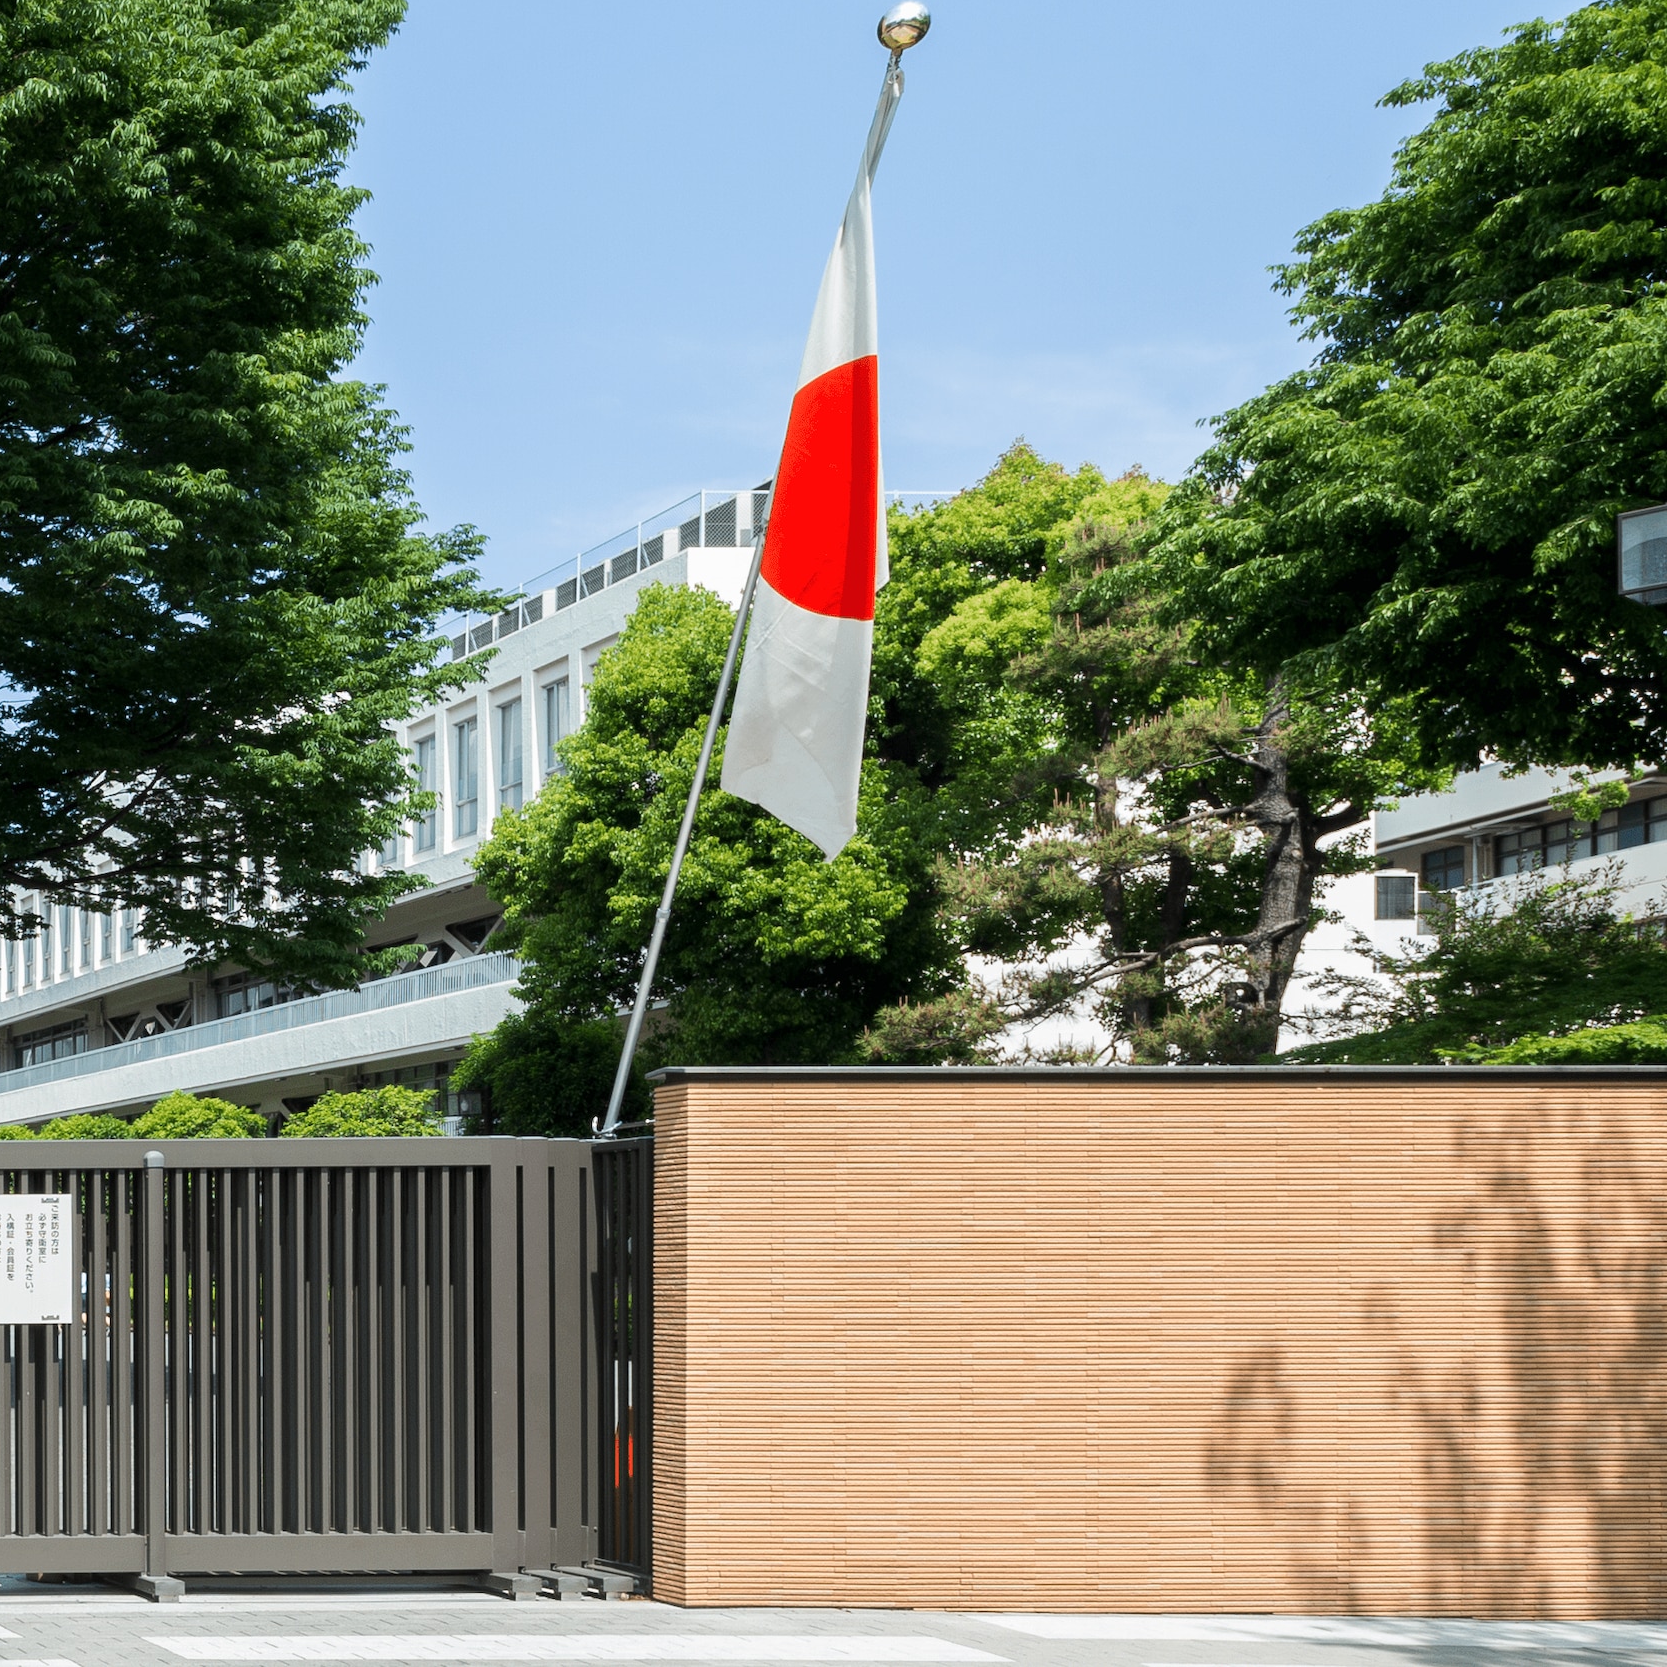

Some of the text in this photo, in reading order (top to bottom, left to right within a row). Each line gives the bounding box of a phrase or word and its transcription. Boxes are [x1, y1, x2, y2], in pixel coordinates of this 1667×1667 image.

[25, 1213, 34, 1293] お立ち寄りください。
[38, 1213, 47, 1264] 必ず守衛室に
[51, 1204, 59, 1255] ご来訪の方は
